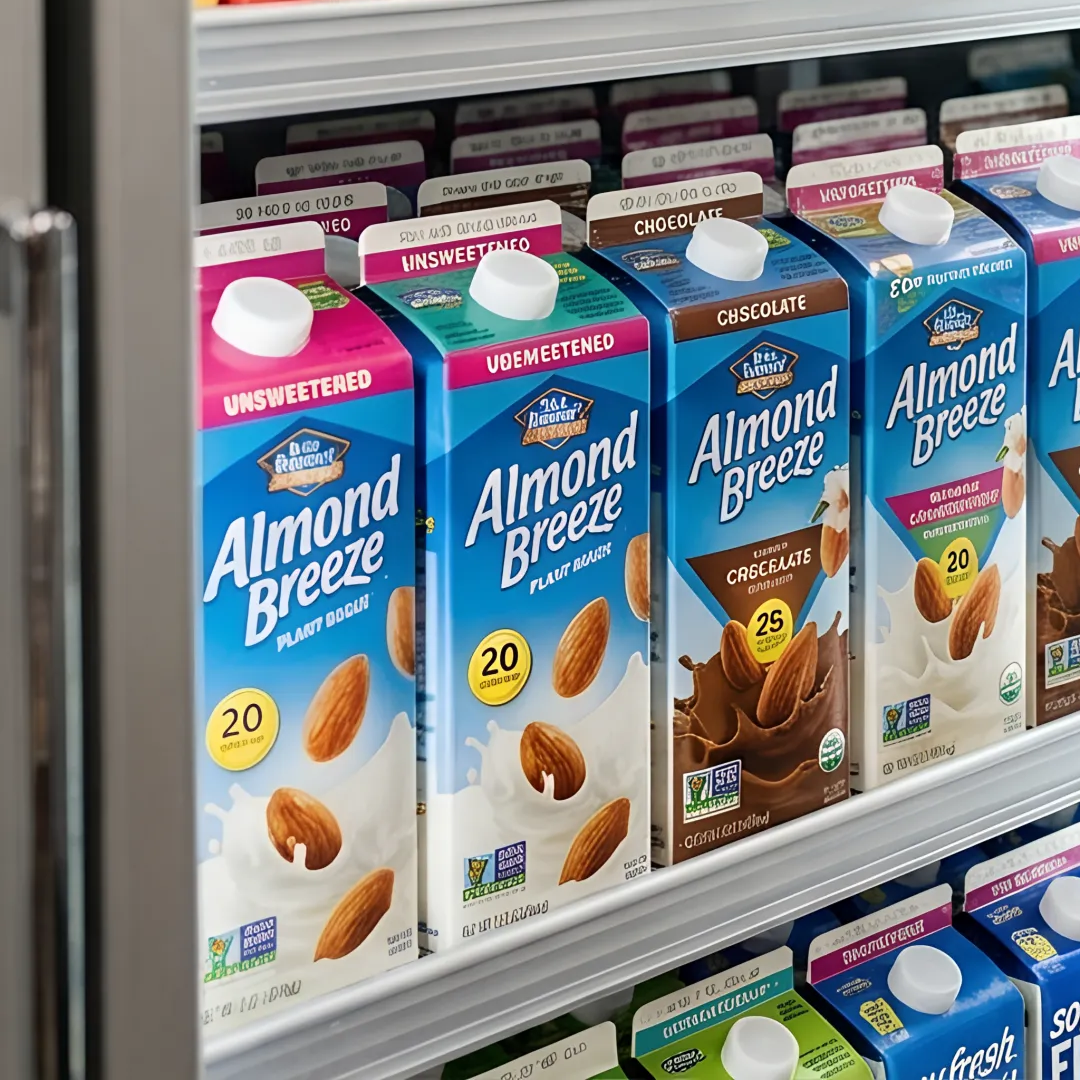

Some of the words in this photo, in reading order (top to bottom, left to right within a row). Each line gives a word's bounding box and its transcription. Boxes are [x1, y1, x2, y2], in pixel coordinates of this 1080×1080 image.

[688, 364, 839, 485] Almond
[885, 322, 1018, 430] Almond
[912, 382, 1006, 467] Breeze
[203, 453, 401, 603] Almond
[464, 409, 639, 548] Almond
[719, 430, 825, 524] Breeze
[244, 530, 385, 647] Breeze
[500, 482, 623, 590] Breeze
[947, 548, 969, 573] 20
[481, 642, 519, 677] 20
[221, 703, 263, 739] 20
